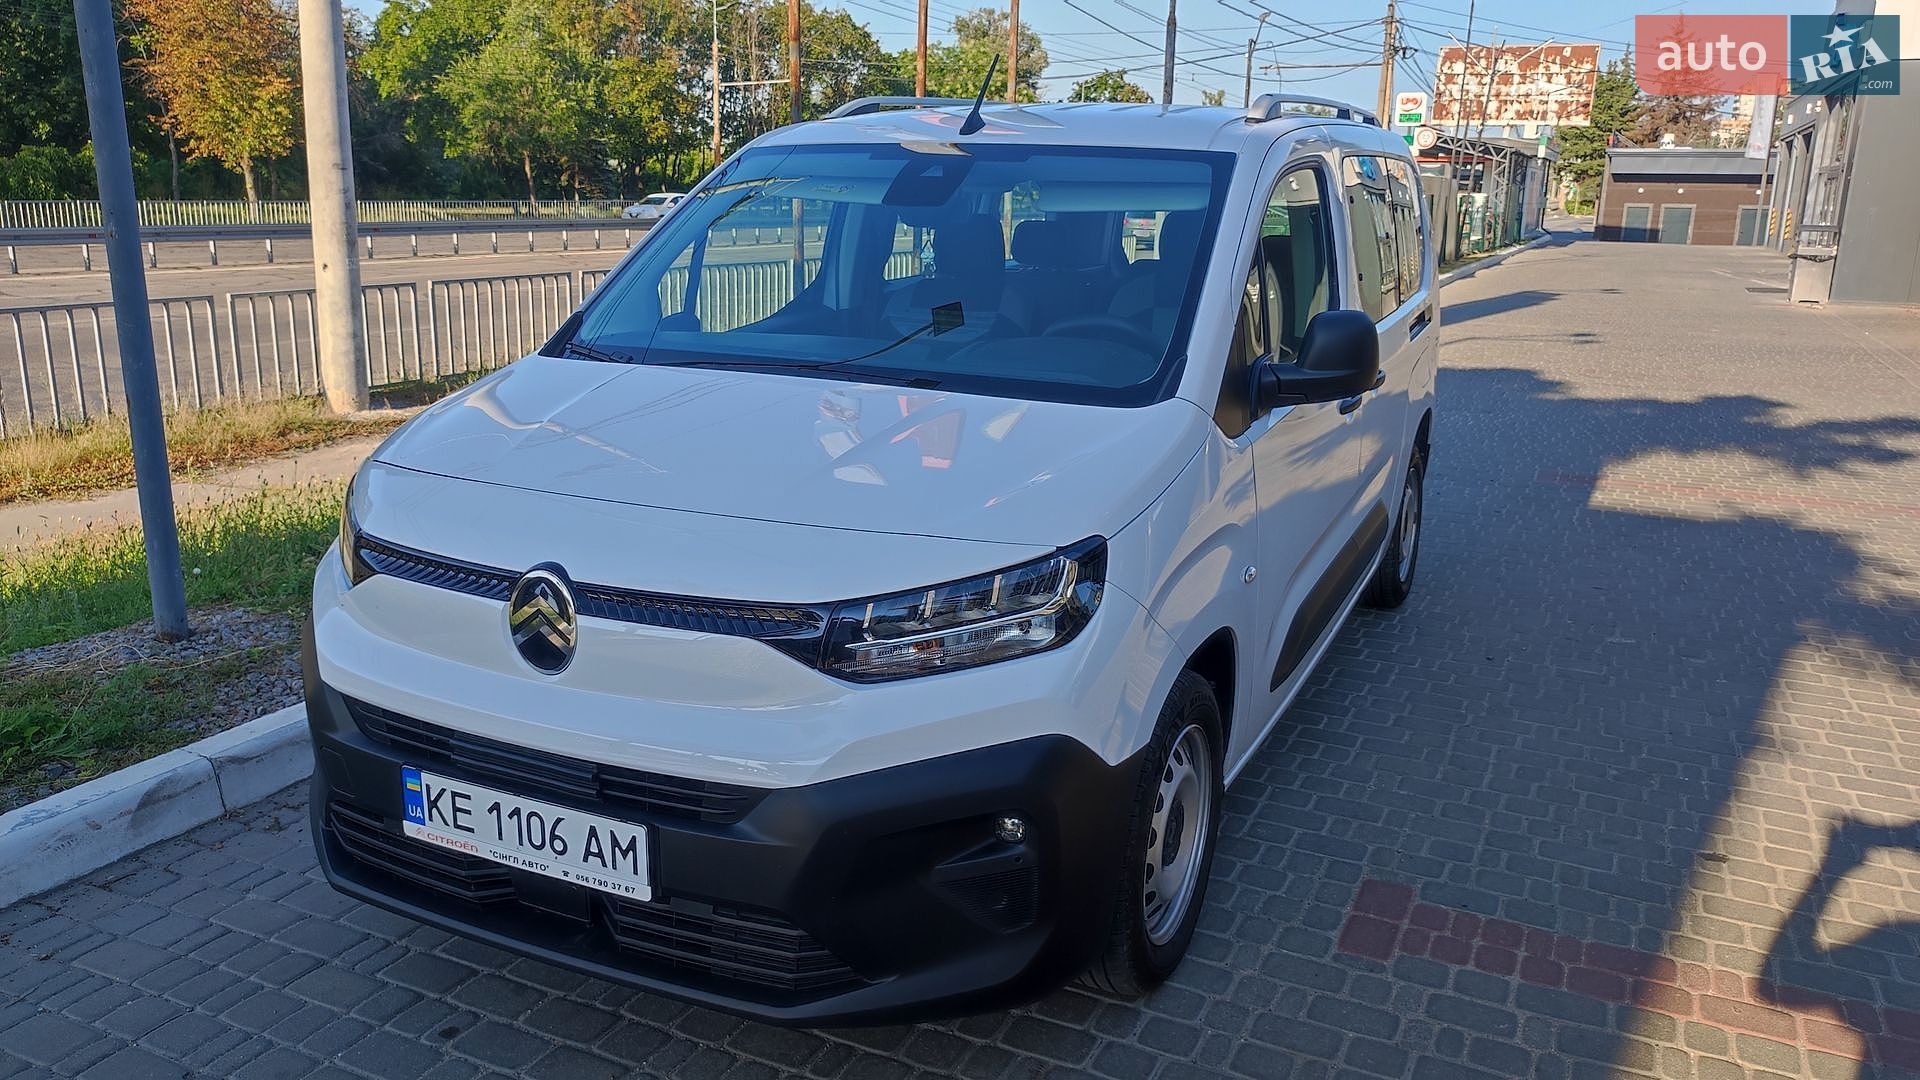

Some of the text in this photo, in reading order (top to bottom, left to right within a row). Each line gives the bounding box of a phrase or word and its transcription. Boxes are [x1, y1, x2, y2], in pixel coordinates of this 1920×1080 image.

[408, 803, 424, 819] UA
[425, 783, 639, 876] KE 1106 AM
[575, 873, 636, 895] 056 790 37 67
